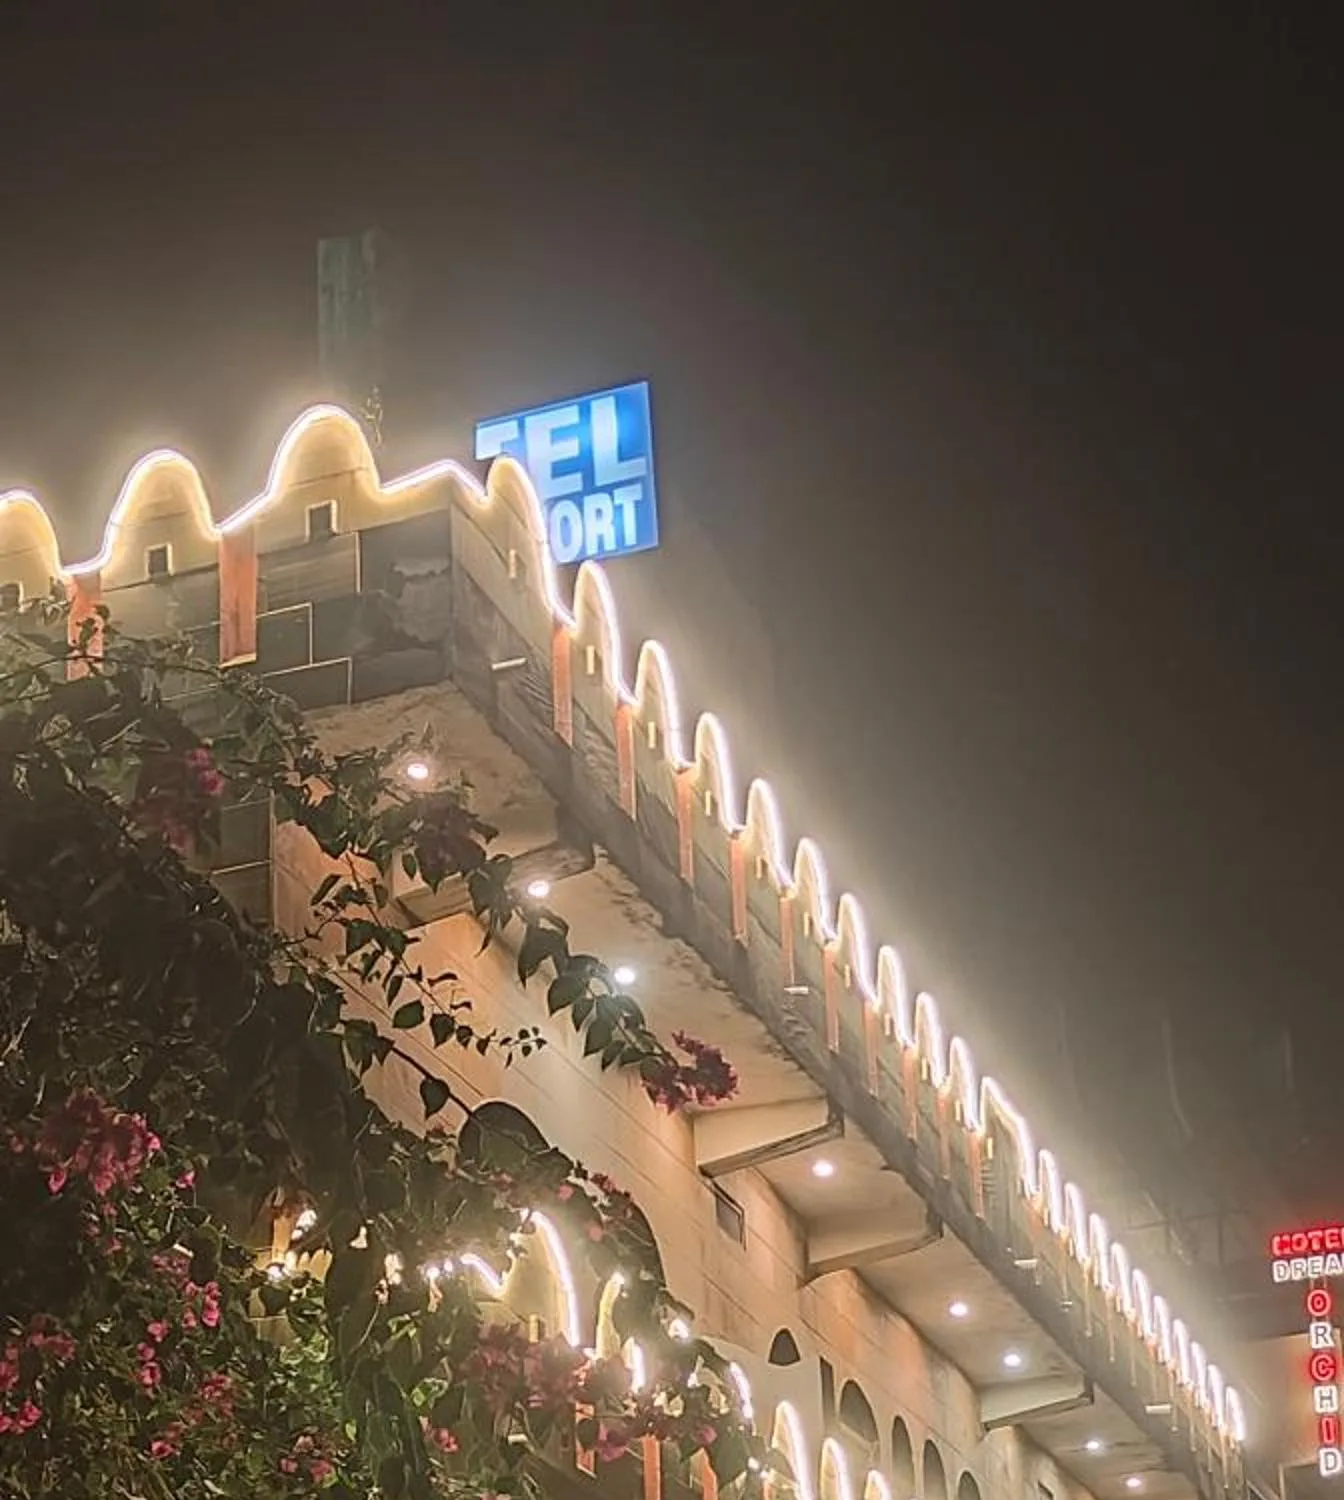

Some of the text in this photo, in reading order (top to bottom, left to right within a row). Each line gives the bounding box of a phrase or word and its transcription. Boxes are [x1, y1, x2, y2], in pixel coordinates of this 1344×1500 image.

[545, 484, 642, 563] ORT
[1272, 1228, 1344, 1256] HOTE
[1273, 1253, 1344, 1283] DREA
[1307, 1289, 1342, 1476] ORCHID
